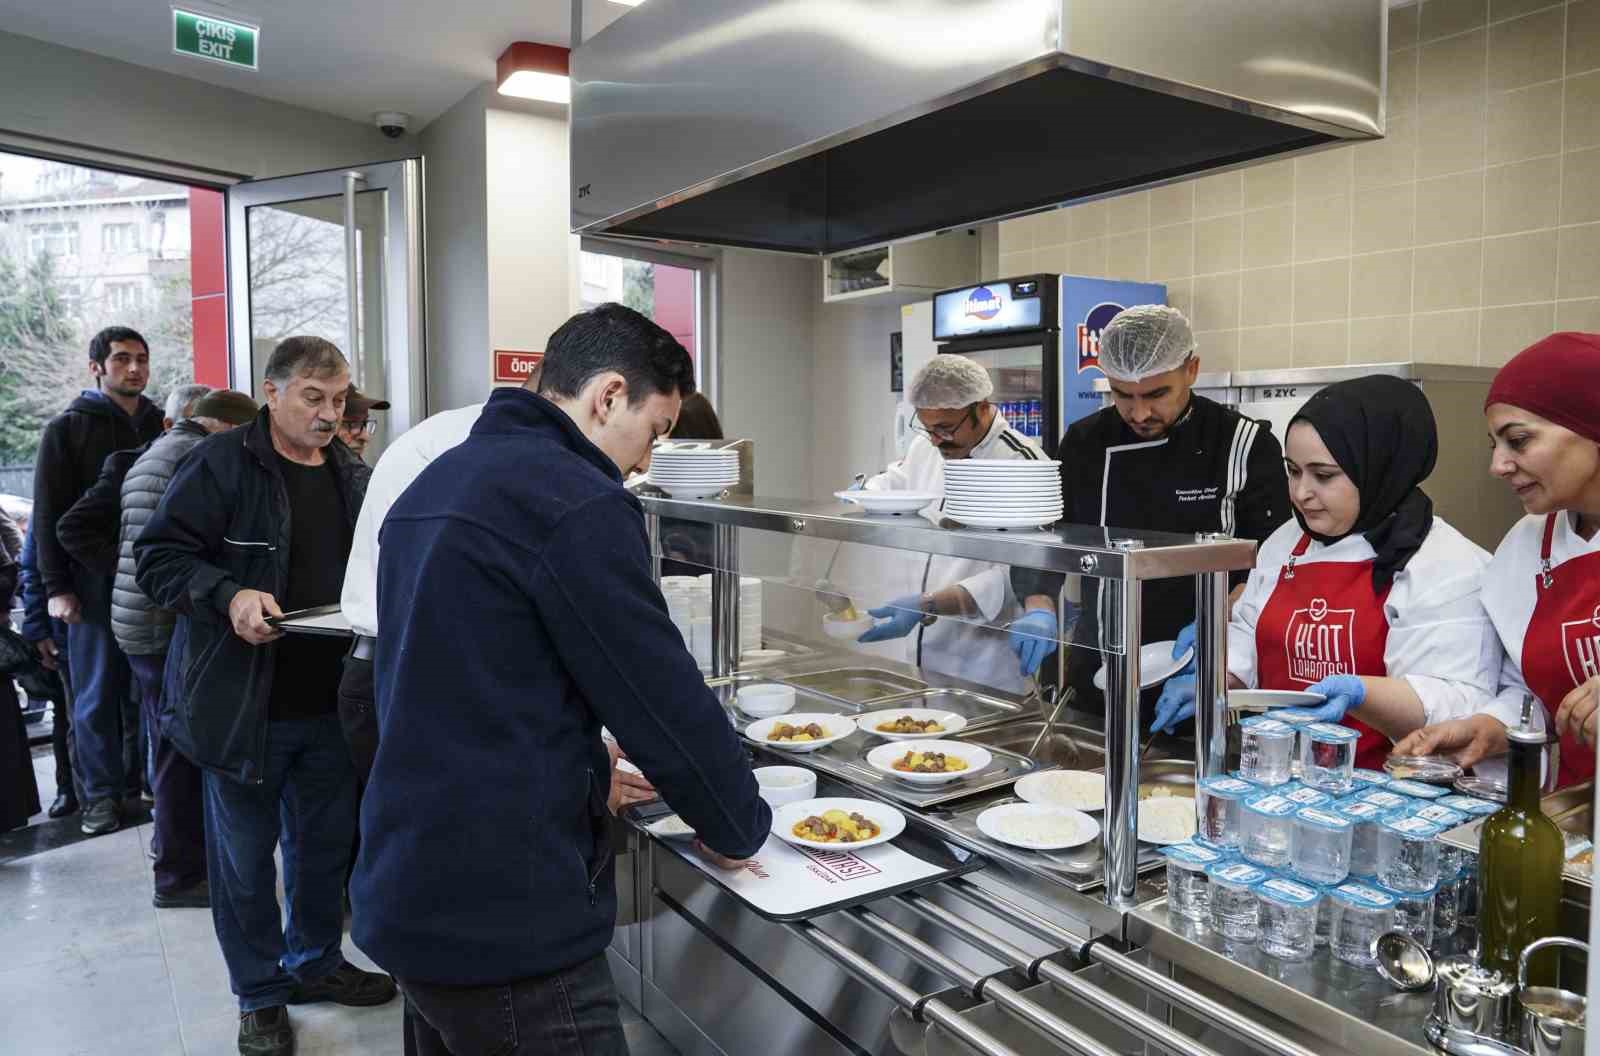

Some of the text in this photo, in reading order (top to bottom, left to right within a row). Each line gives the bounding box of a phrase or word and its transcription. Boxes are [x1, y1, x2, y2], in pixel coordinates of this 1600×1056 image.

[195, 19, 236, 46] ÇIKIŞ
[199, 39, 232, 59] EXIT
[1274, 387, 1297, 399] ZYC
